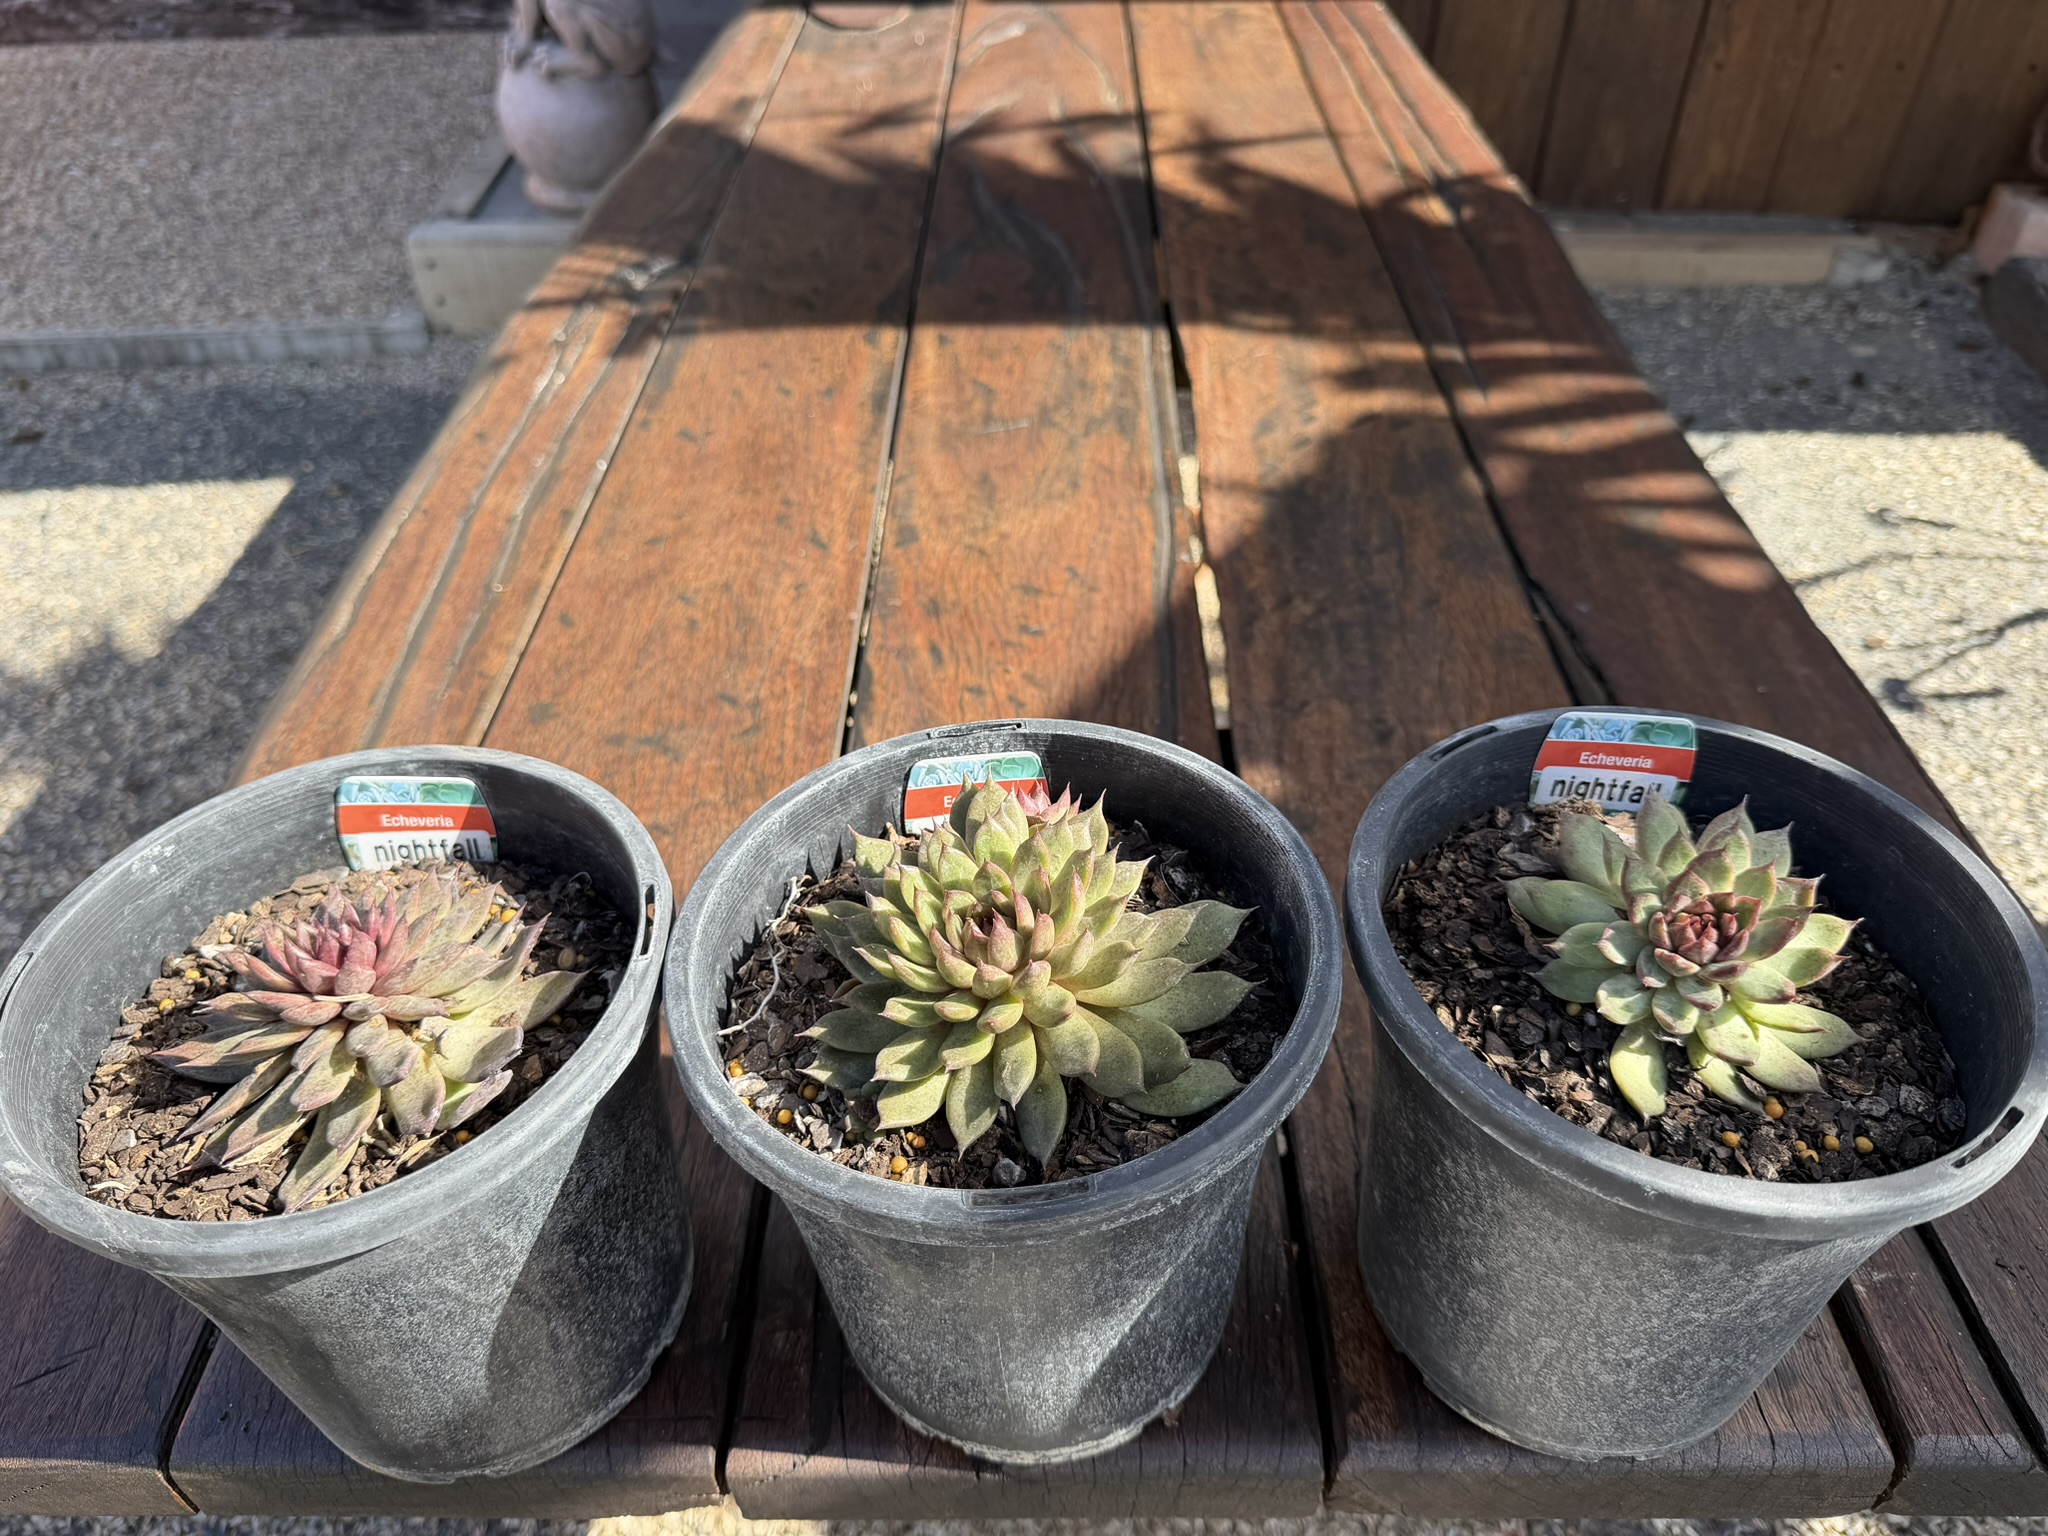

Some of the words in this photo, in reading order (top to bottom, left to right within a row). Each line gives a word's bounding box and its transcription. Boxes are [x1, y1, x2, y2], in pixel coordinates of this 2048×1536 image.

[1579, 752, 1652, 769] Echeveria
[381, 814, 454, 827] Echeveria
[374, 837, 481, 862] nightfall
